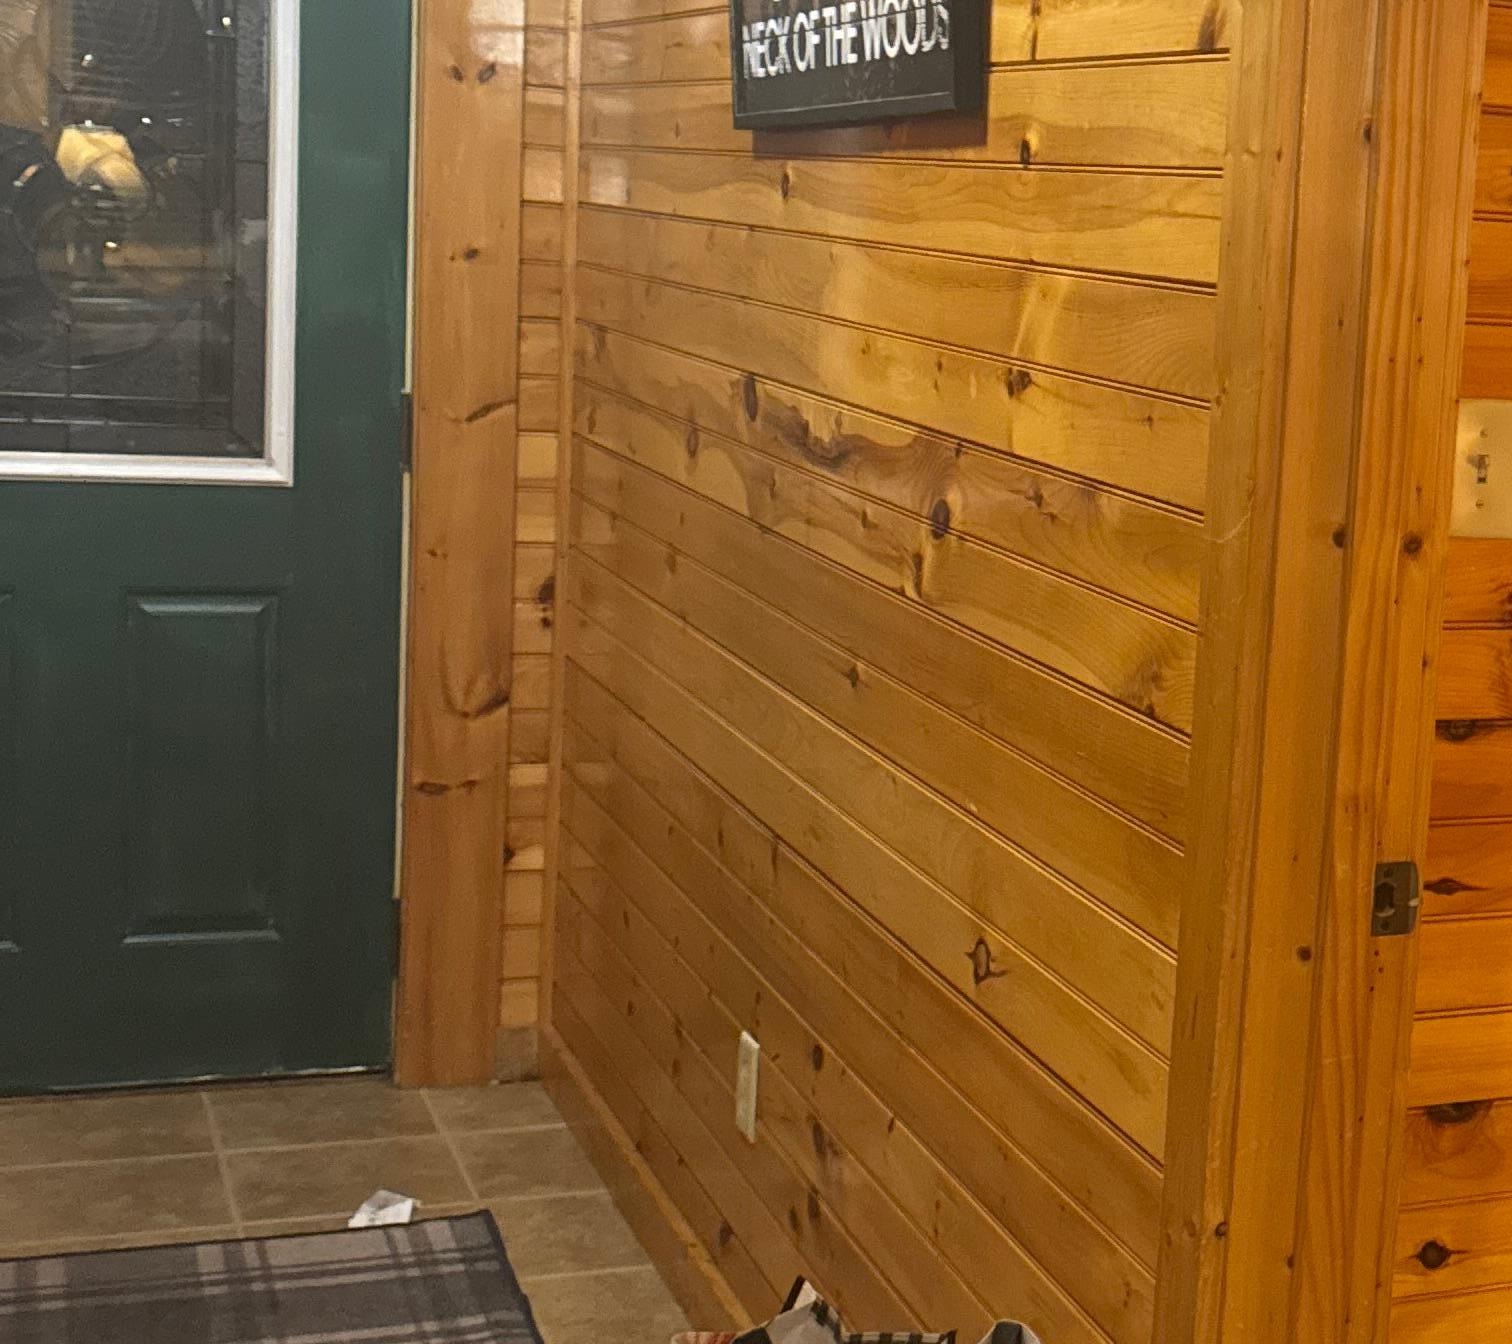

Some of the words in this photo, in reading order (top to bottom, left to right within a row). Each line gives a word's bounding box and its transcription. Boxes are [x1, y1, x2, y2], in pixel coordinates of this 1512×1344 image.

[742, 15, 792, 80] NECK
[793, 9, 820, 72] OF
[821, 1, 858, 68] THE
